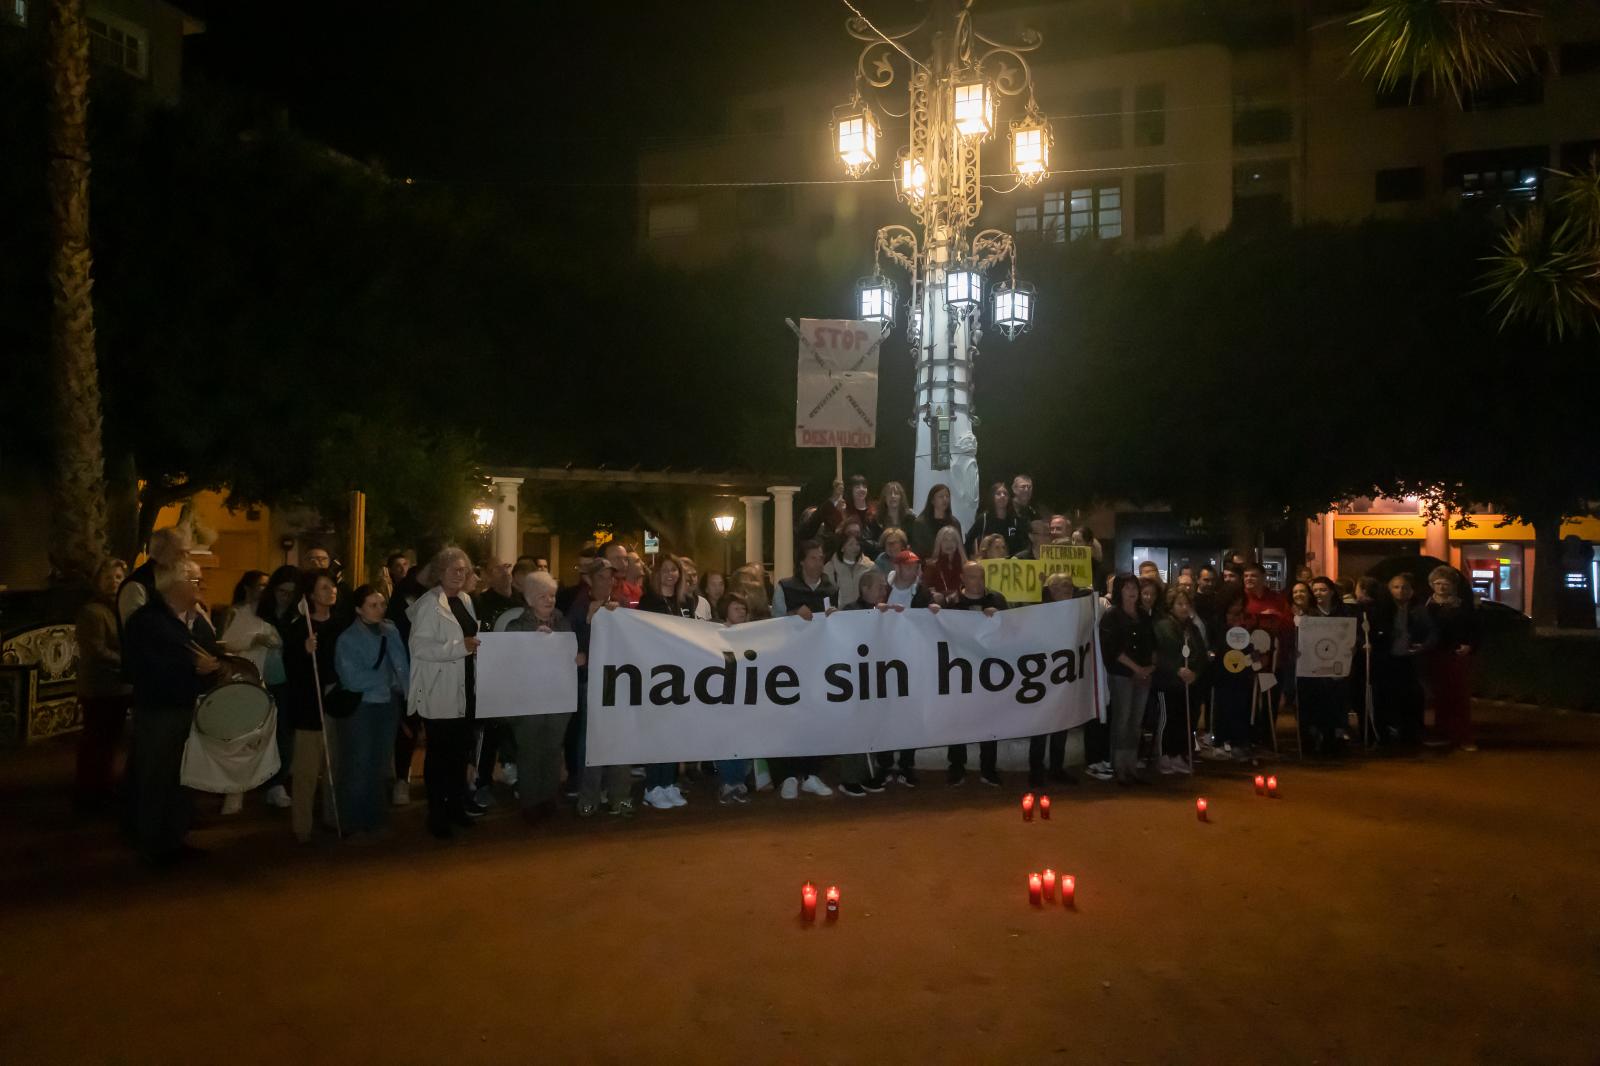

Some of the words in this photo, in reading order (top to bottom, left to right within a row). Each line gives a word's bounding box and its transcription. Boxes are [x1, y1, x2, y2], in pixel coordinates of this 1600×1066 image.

[814, 326, 868, 351] STOP
[1361, 525, 1414, 536] CORREOS
[602, 649, 801, 707] nadie
[825, 643, 909, 703] sin
[938, 641, 1092, 705] hogar
